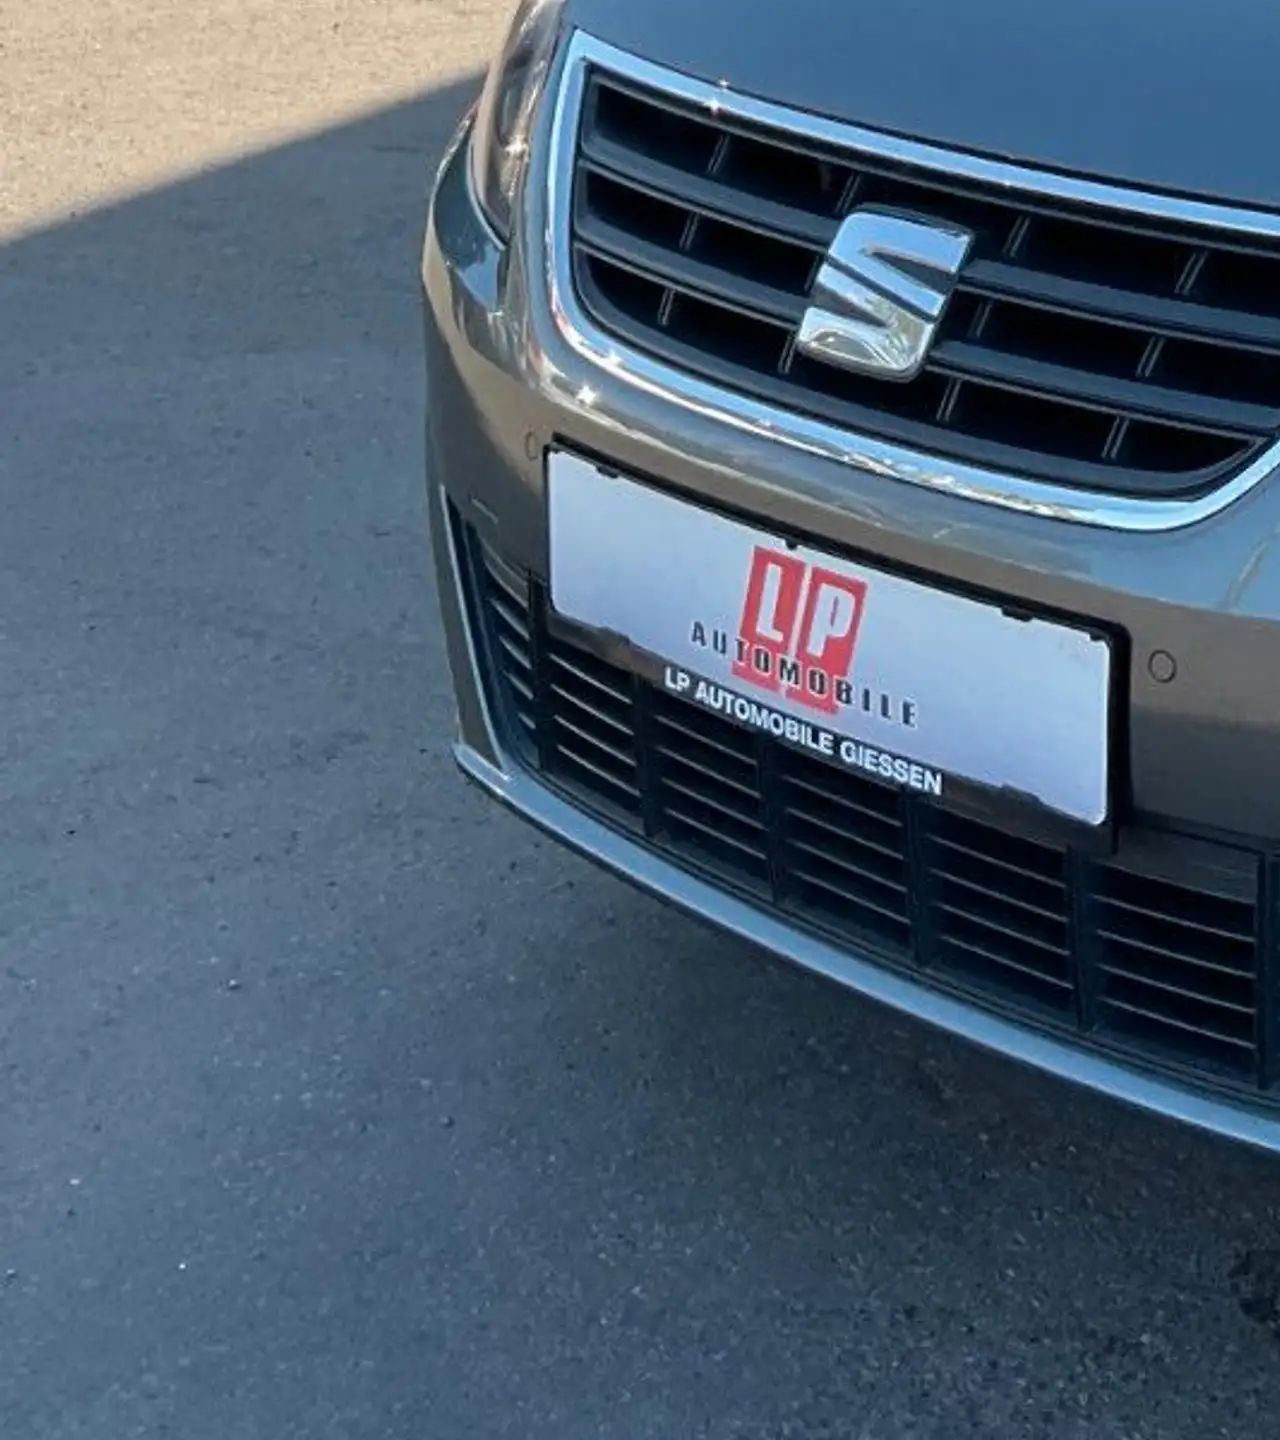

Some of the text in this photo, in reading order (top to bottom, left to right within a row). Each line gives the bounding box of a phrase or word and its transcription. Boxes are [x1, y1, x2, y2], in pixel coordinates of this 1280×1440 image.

[755, 562, 857, 659] LP
[690, 620, 919, 728] AUTOMOBILE
[664, 666, 943, 796] LP AUTOMOBILE GIESSEN
